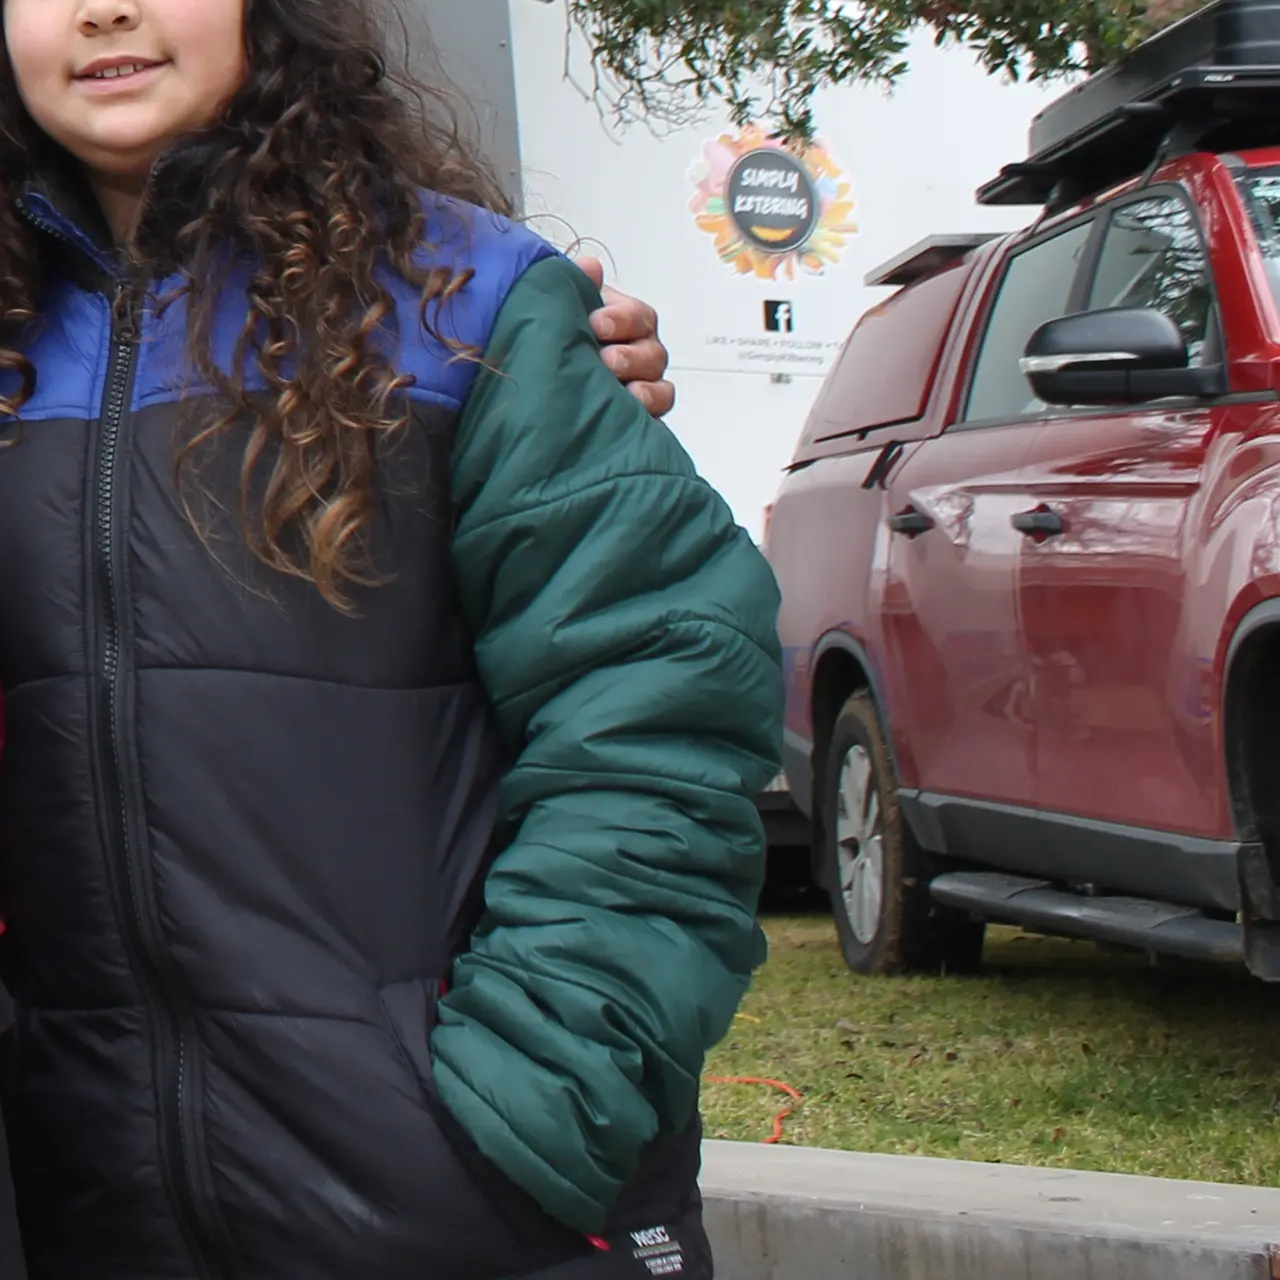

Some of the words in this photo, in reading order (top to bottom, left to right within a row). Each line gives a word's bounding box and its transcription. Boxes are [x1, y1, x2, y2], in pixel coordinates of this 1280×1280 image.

[740, 167, 800, 193] SIMPLY
[705, 335, 727, 345] LIKE
[737, 337, 770, 347] SHARE
[781, 338, 823, 350] FOLLOW
